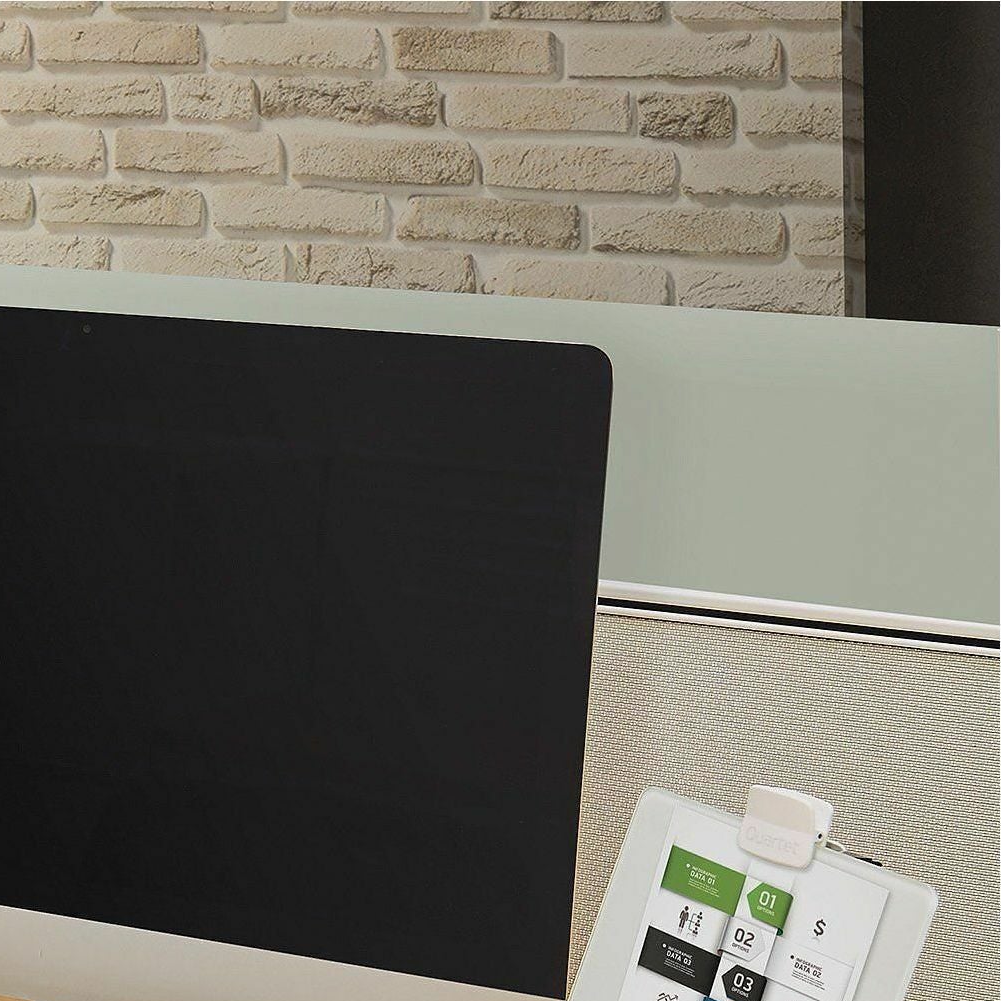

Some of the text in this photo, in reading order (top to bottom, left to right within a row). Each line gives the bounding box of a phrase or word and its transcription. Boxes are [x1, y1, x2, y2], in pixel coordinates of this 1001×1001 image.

[690, 870, 716, 886] DATA 01
[759, 891, 776, 909] 01
[734, 928, 755, 947] 02
[666, 949, 692, 966] DATA 03
[794, 961, 822, 979] DATA 02
[733, 973, 754, 992] 03
